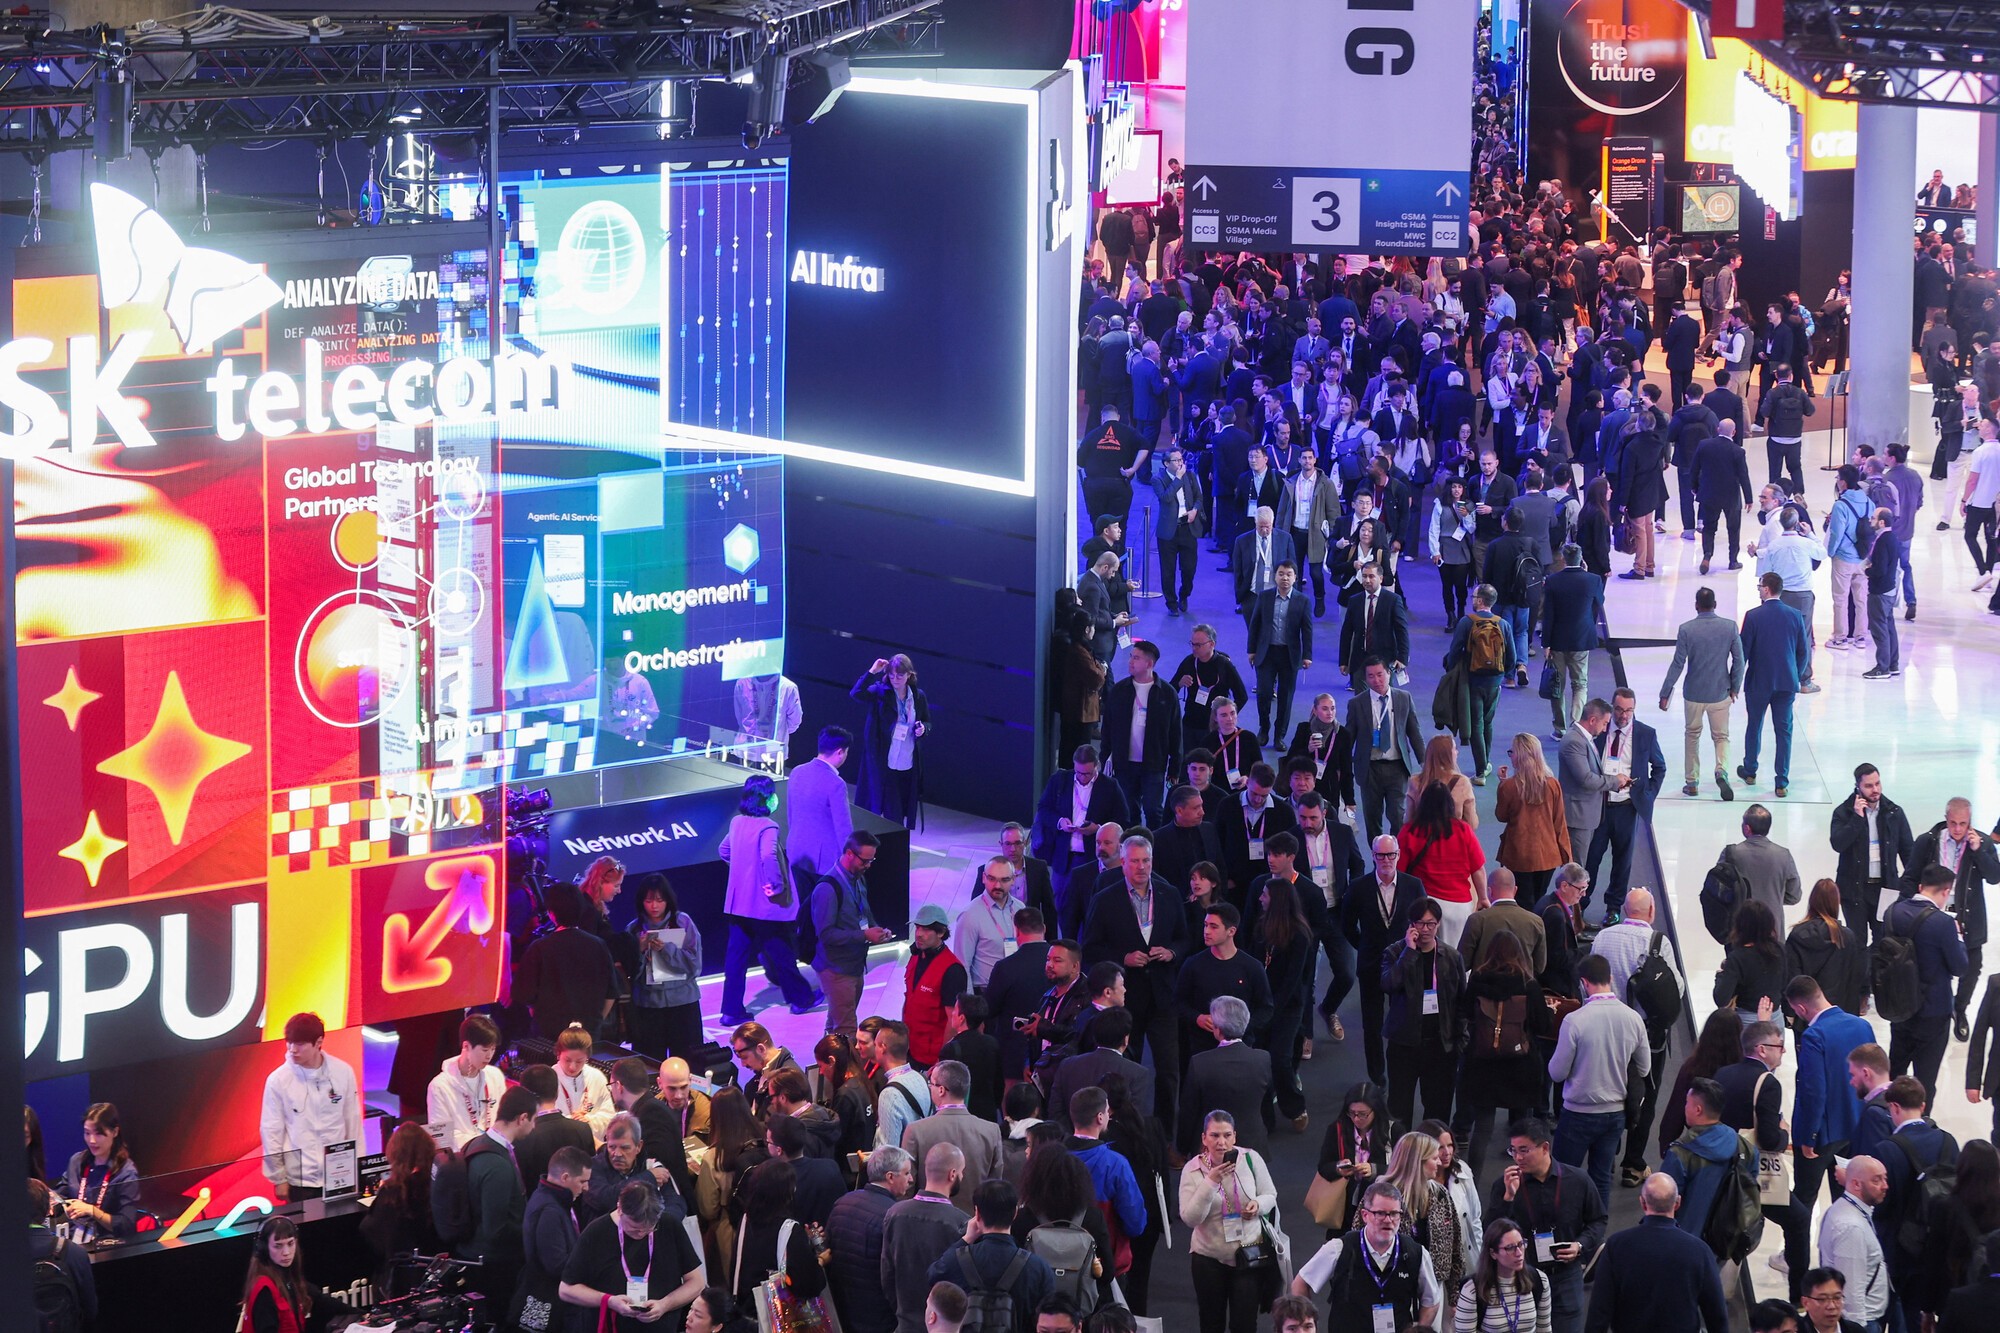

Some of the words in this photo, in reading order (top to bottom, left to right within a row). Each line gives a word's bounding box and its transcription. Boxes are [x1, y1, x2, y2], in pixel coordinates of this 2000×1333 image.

[1586, 19, 1650, 40] Trust
[1590, 42, 1628, 60] the
[1590, 62, 1656, 82] future
[1241, 215, 1277, 224] Drop-Off
[1310, 190, 1341, 232] 3
[1401, 213, 1427, 221] GSMA
[1194, 225, 1217, 235] CC3
[1225, 227, 1251, 235] GSMA
[1252, 227, 1277, 235] Media
[1376, 220, 1408, 229] Insights
[1409, 221, 1427, 229] Hub
[1225, 235, 1253, 245] Village
[1375, 239, 1426, 248] Roundtables
[1404, 232, 1426, 240] MWC
[1435, 231, 1457, 240] CC2
[790, 249, 817, 285] AI
[821, 253, 879, 293] Infra
[283, 272, 391, 310] ANALYZING
[284, 327, 305, 339] DEF
[0, 330, 156, 460] SK
[206, 338, 569, 442] telecom
[284, 462, 357, 491] Global
[360, 455, 480, 485] Technology
[284, 494, 379, 519] Partners
[527, 512, 560, 522] Agentic
[560, 513, 571, 521] AI
[613, 578, 750, 615] Management
[624, 637, 767, 675] Orchestration
[563, 826, 665, 856] Network
[667, 821, 699, 841] AI
